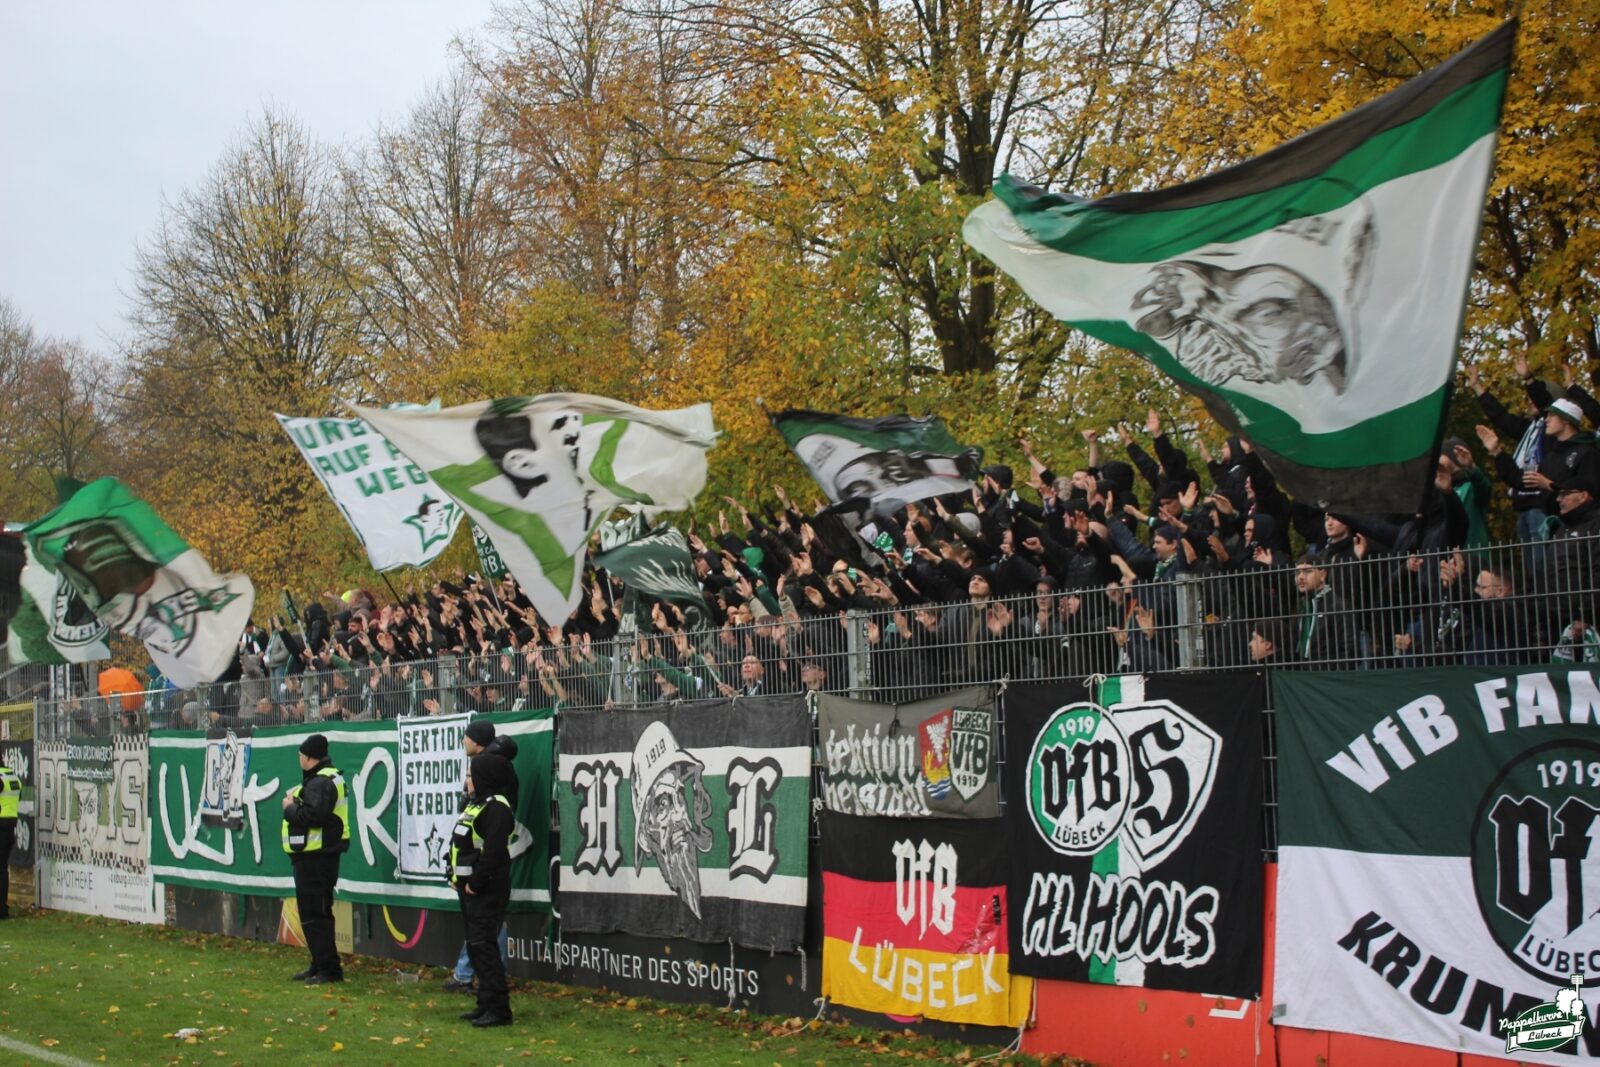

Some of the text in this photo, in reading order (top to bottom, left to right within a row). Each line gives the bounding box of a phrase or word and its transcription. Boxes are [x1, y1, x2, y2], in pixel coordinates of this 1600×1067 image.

[315, 444, 370, 476] AUF
[355, 464, 428, 497] WEG
[953, 711, 989, 729] LÜBECK
[1058, 716, 1095, 738] 1919
[402, 726, 466, 754] SEKTION
[645, 738, 666, 769] 1919
[952, 731, 989, 776] VfB
[1325, 694, 1459, 793] VfB
[406, 758, 462, 785] STADION
[956, 774, 979, 787] 1919
[571, 760, 623, 877] H
[1055, 821, 1106, 846] LÜBECK
[507, 935, 760, 996] BILITÄTSPARTNER DES SPORTS
[848, 926, 1006, 1009] LÜBECK
